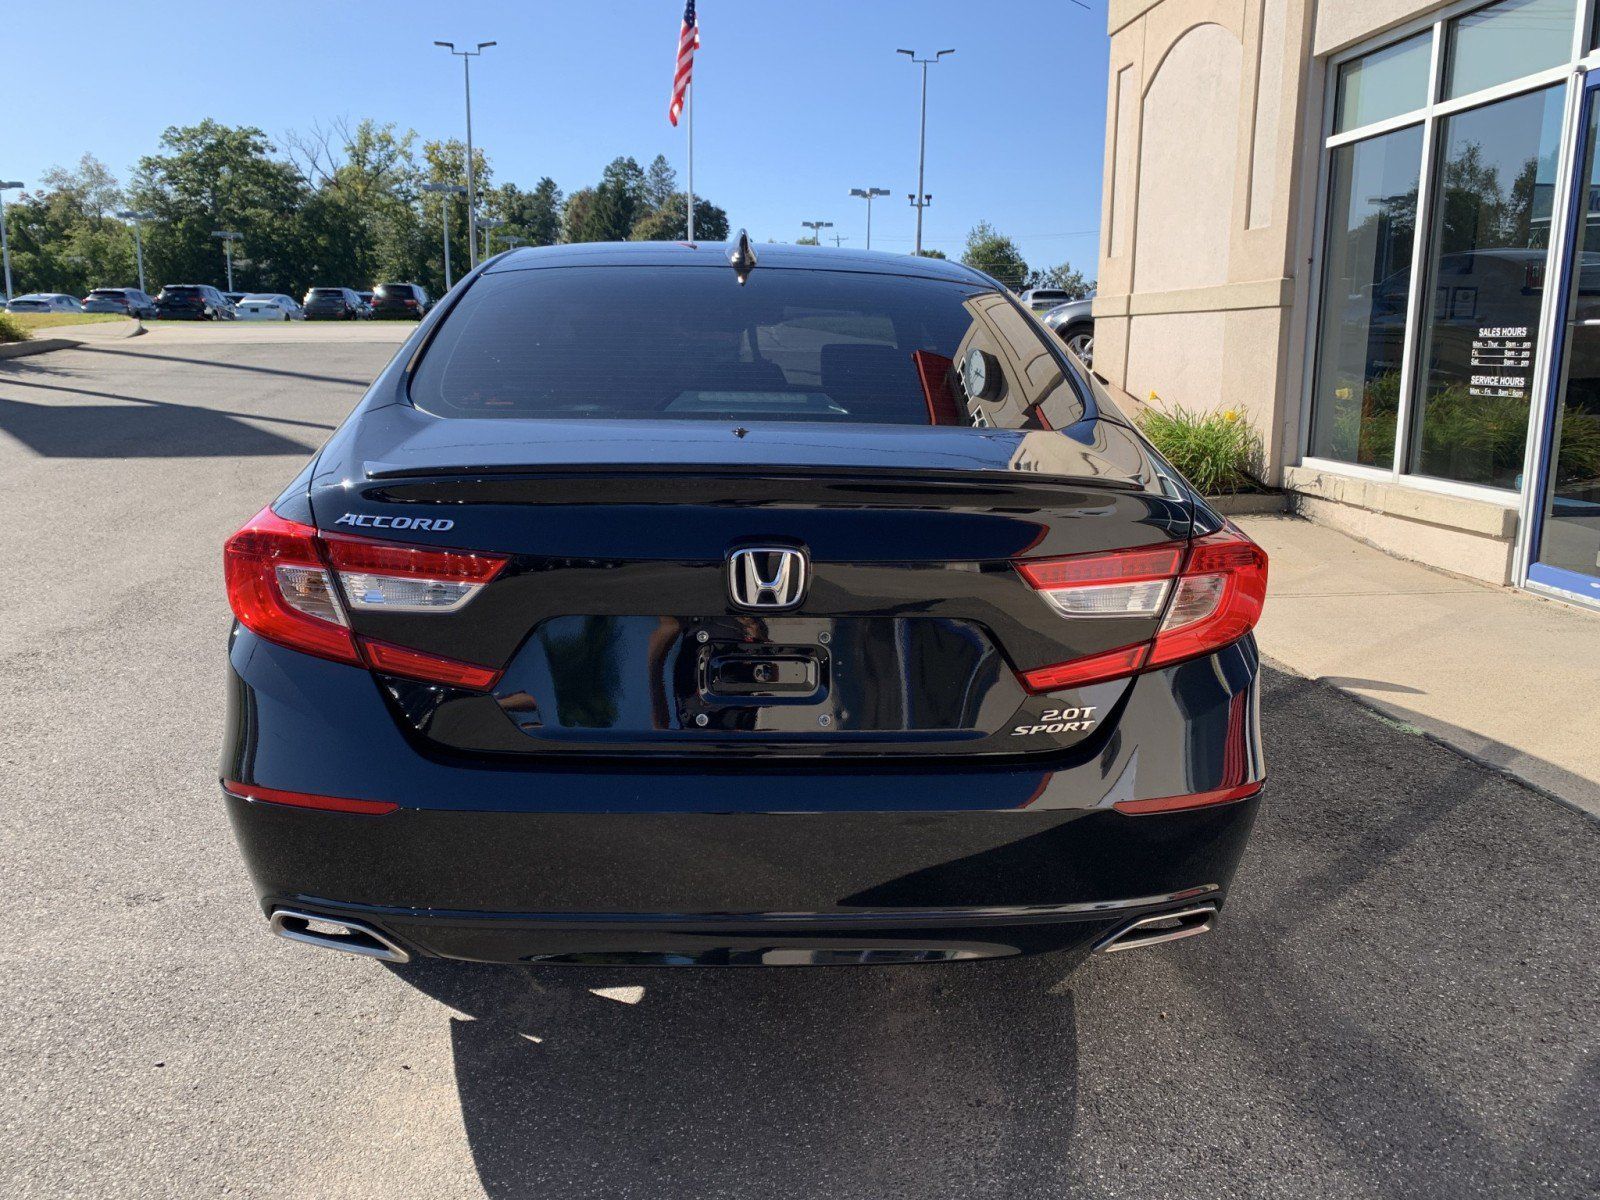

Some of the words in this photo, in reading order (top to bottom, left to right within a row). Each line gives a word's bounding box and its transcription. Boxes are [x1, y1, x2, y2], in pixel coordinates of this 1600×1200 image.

[1479, 327, 1500, 336] SALES
[1502, 327, 1527, 336] HOURS
[1471, 375, 1499, 385] SERVICE
[1500, 376, 1524, 386] HOURS
[334, 512, 455, 532] ACCORD
[1041, 706, 1096, 721] 2.0T
[1010, 720, 1095, 736] SPORT
